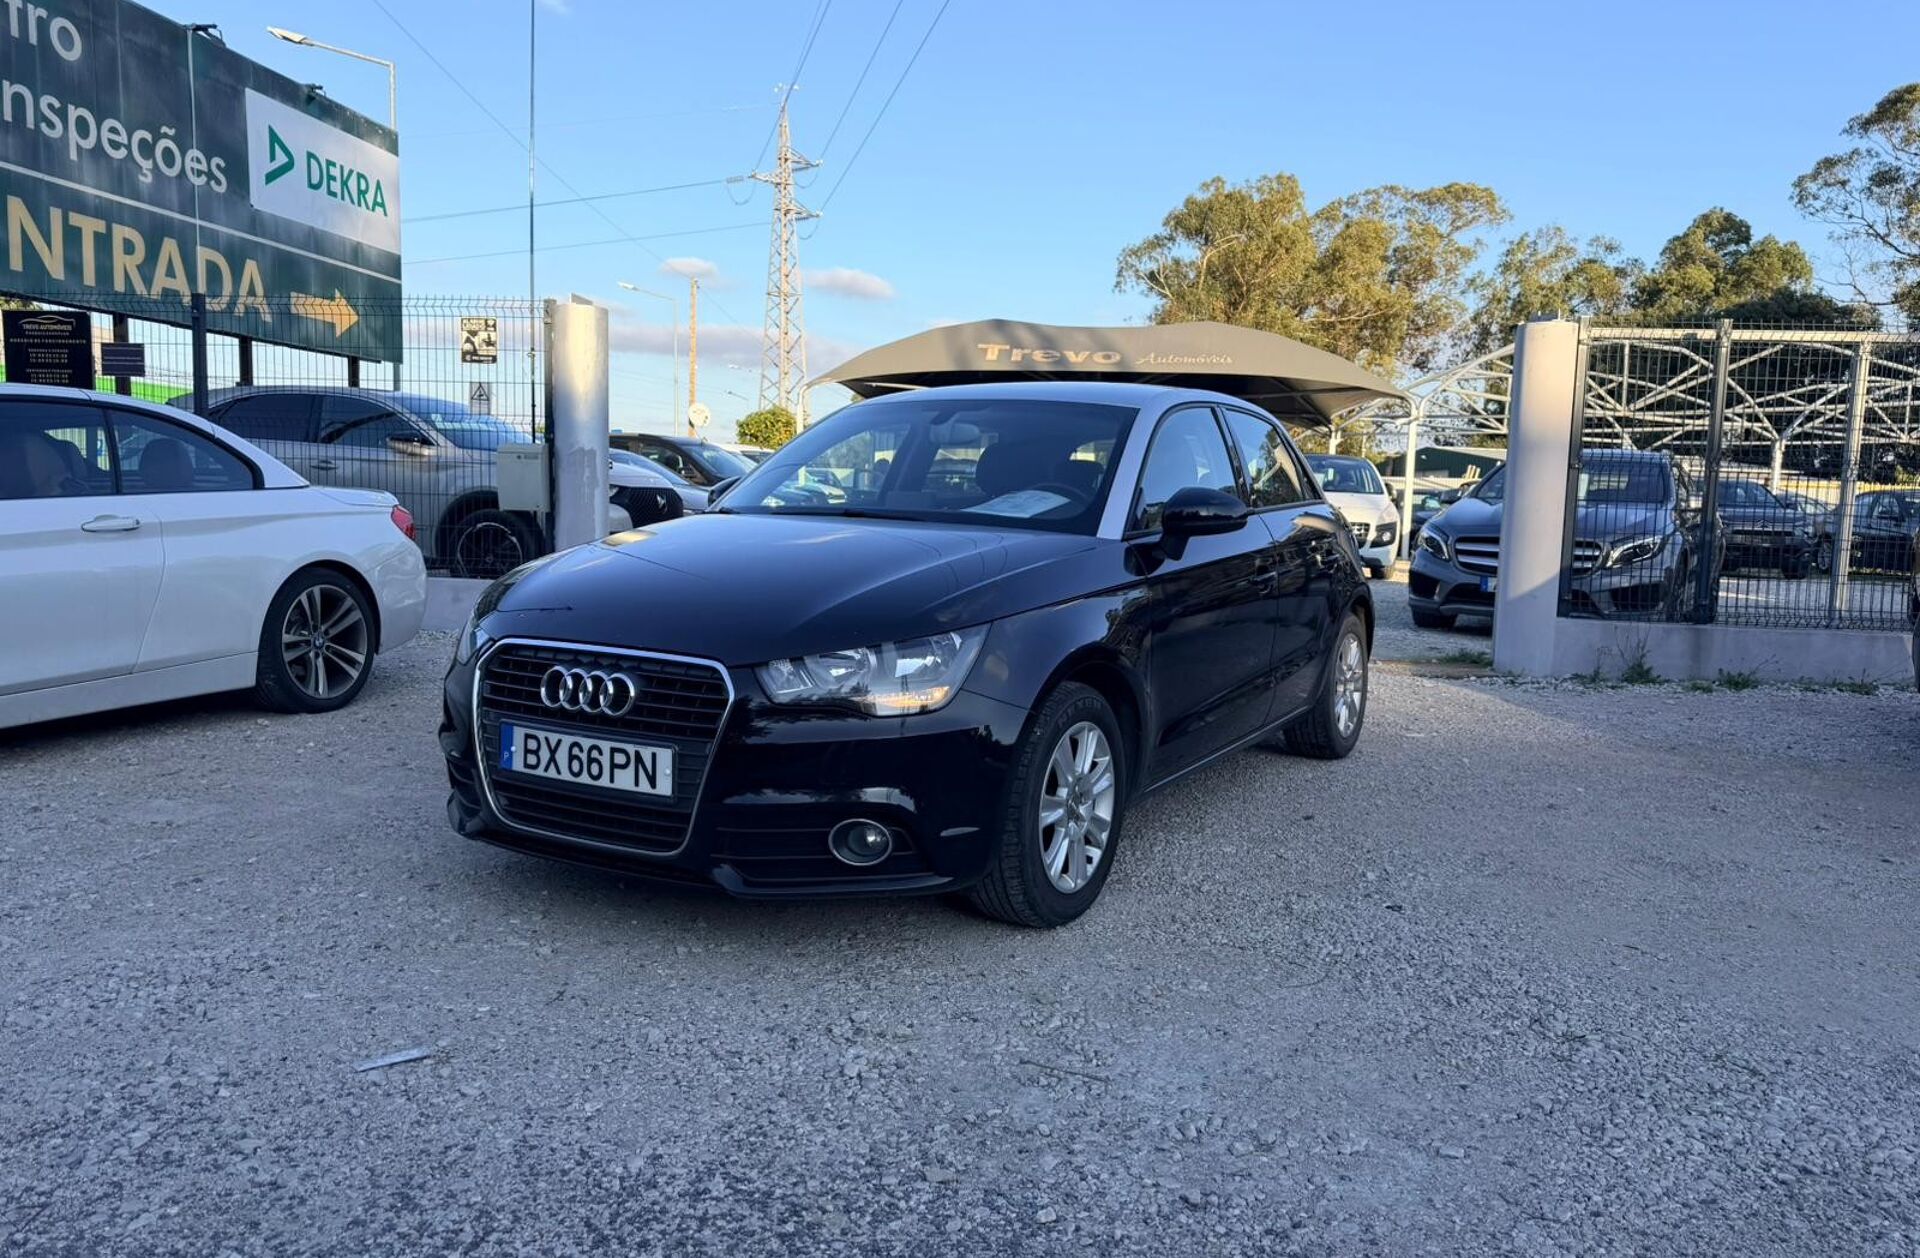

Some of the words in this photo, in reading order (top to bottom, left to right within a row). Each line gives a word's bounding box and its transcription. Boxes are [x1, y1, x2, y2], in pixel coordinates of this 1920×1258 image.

[3, 0, 82, 61] tro
[2, 79, 227, 194] nspeções
[305, 150, 388, 217] DEKRA
[7, 195, 273, 323] NTRADA
[977, 343, 1122, 365] Trevo
[503, 751, 510, 761] P
[523, 733, 657, 790] BX66PN
